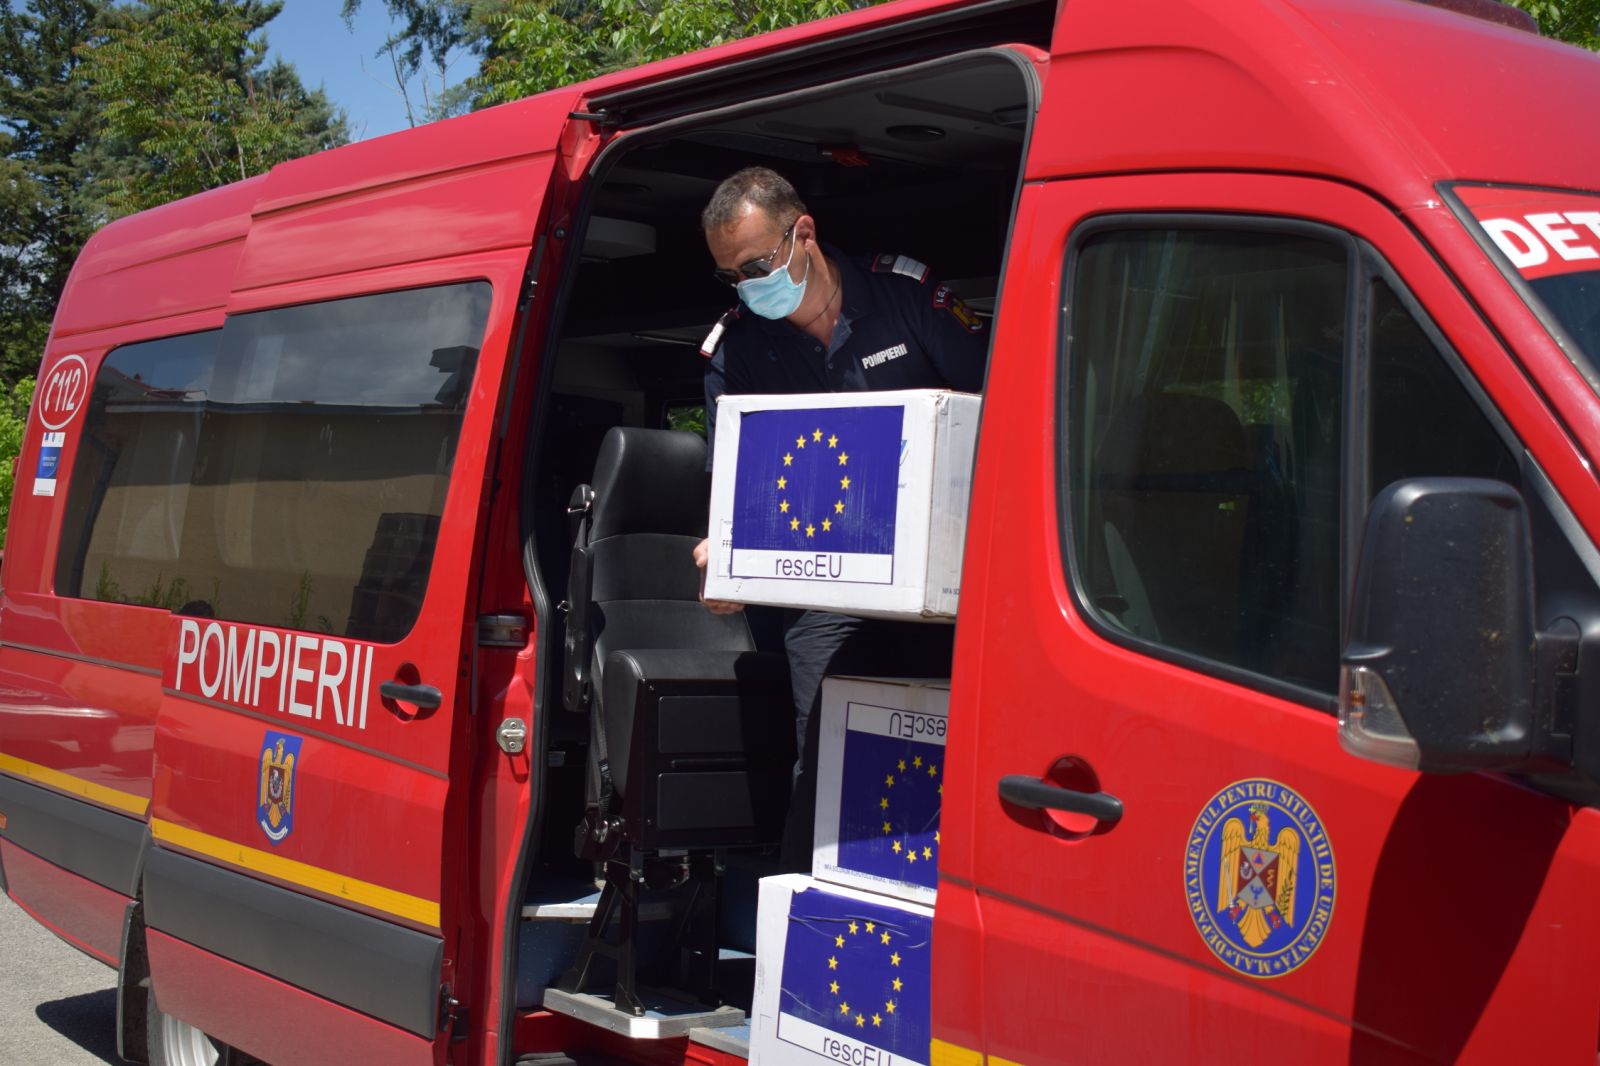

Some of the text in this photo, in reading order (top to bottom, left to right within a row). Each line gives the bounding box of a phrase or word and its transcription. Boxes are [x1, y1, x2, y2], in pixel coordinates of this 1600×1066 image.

[861, 343, 908, 369] POMPIERII
[55, 368, 81, 412] 112
[776, 554, 843, 578] rescEU
[175, 620, 374, 729] POMPIERII
[889, 712, 947, 739] escEU
[1187, 805, 1225, 955] DEPARTAMENTUL
[1219, 783, 1276, 810] PENTRU
[1320, 864, 1333, 890] DE
